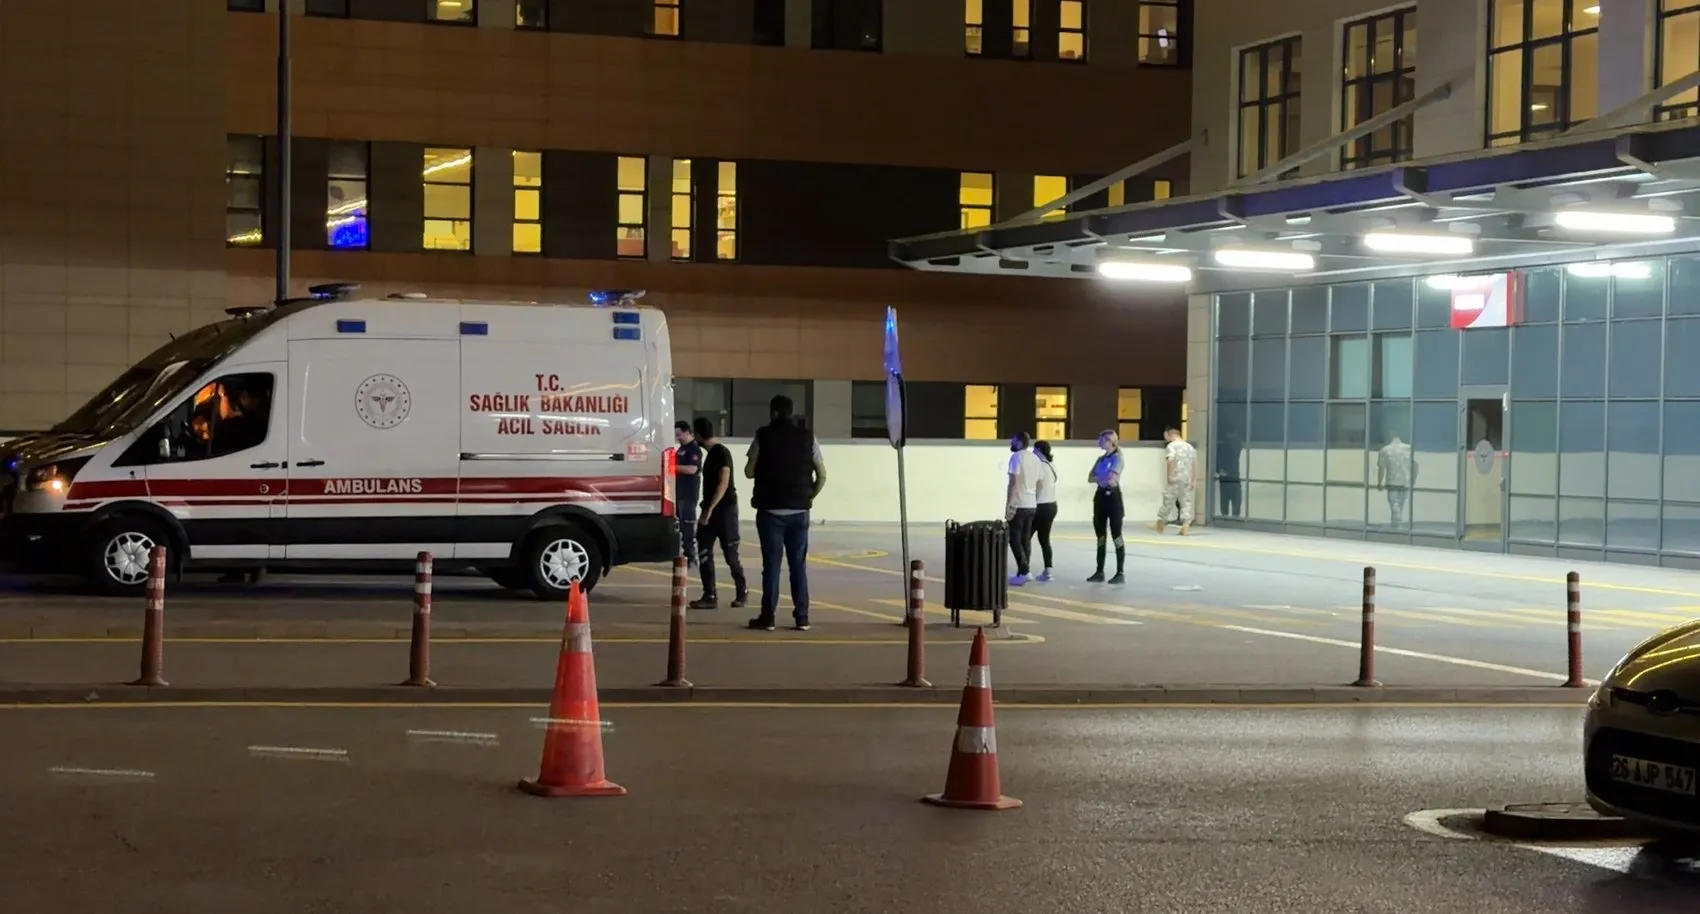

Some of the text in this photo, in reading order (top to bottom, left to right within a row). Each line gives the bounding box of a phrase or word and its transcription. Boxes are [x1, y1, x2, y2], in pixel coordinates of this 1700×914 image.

[535, 374, 564, 391] T.C.
[470, 392, 628, 413] SAĞLIK BAKANLIĞI
[324, 478, 423, 494] AMBULANS
